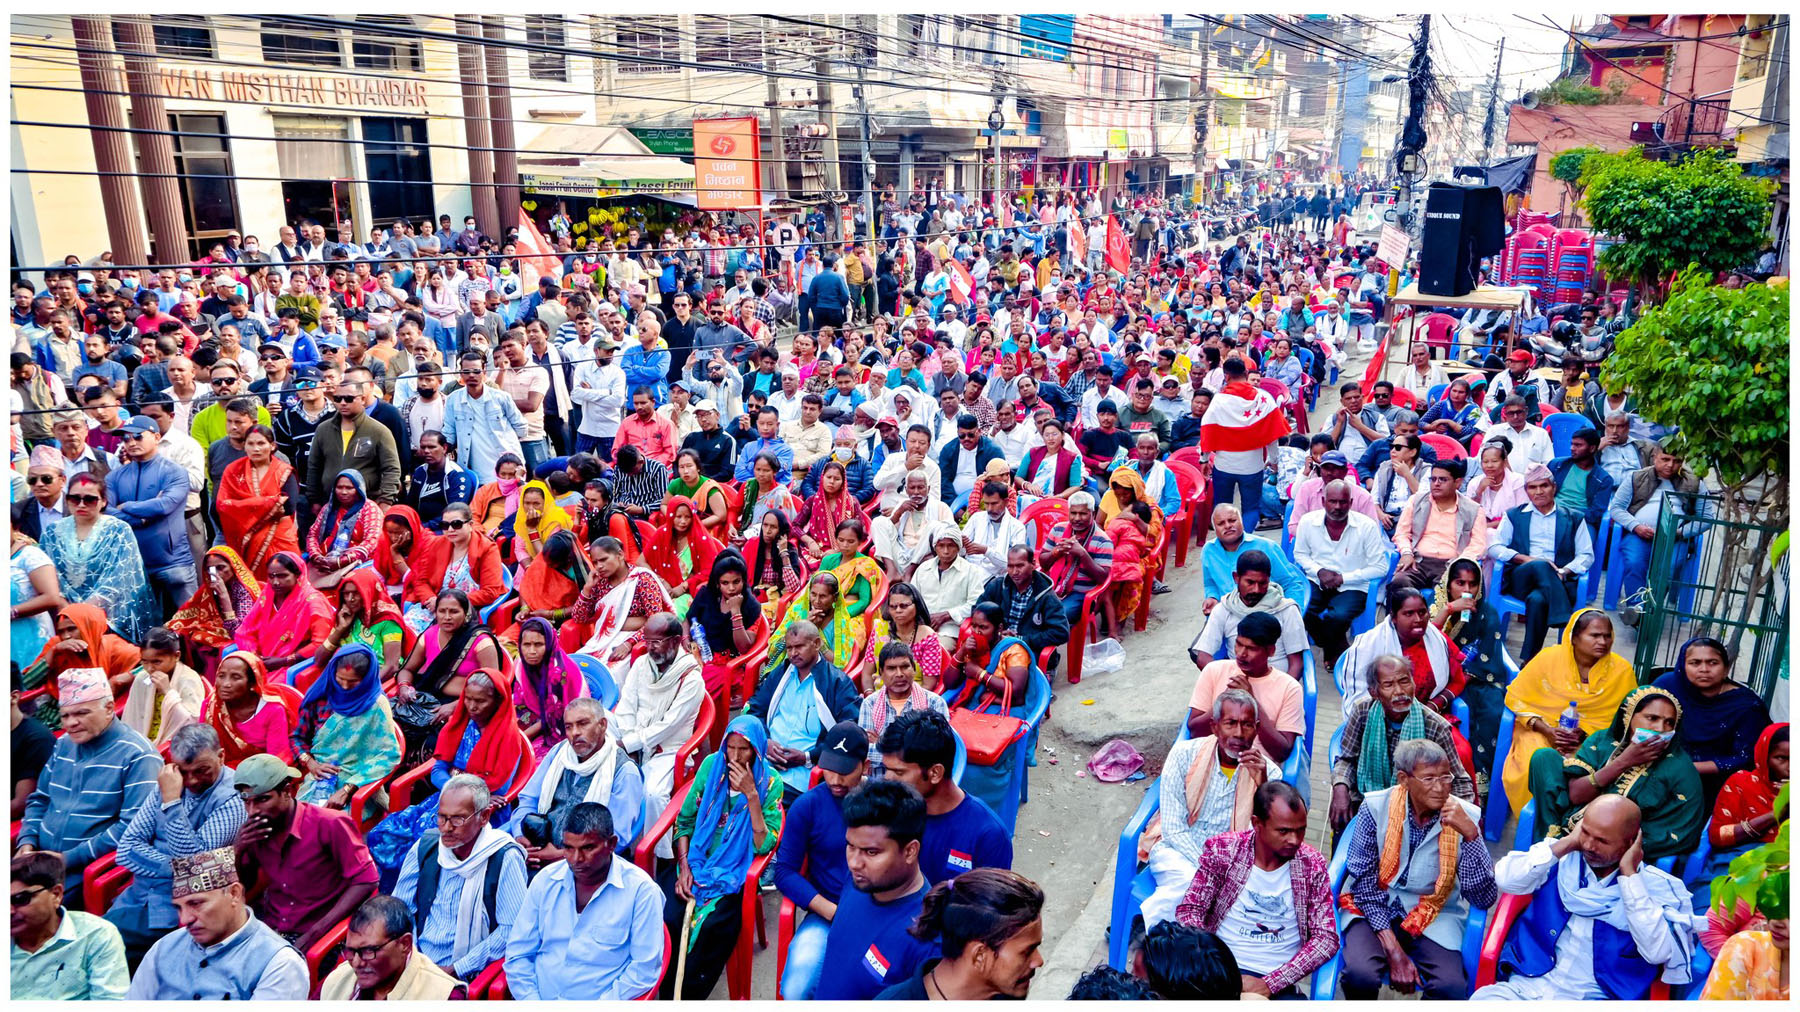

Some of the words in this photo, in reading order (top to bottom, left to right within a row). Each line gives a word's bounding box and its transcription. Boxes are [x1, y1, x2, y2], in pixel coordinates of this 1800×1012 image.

[333, 78, 428, 107] BHANDAR
[781, 228, 792, 248] P
[1130, 421, 1152, 430] UFC
